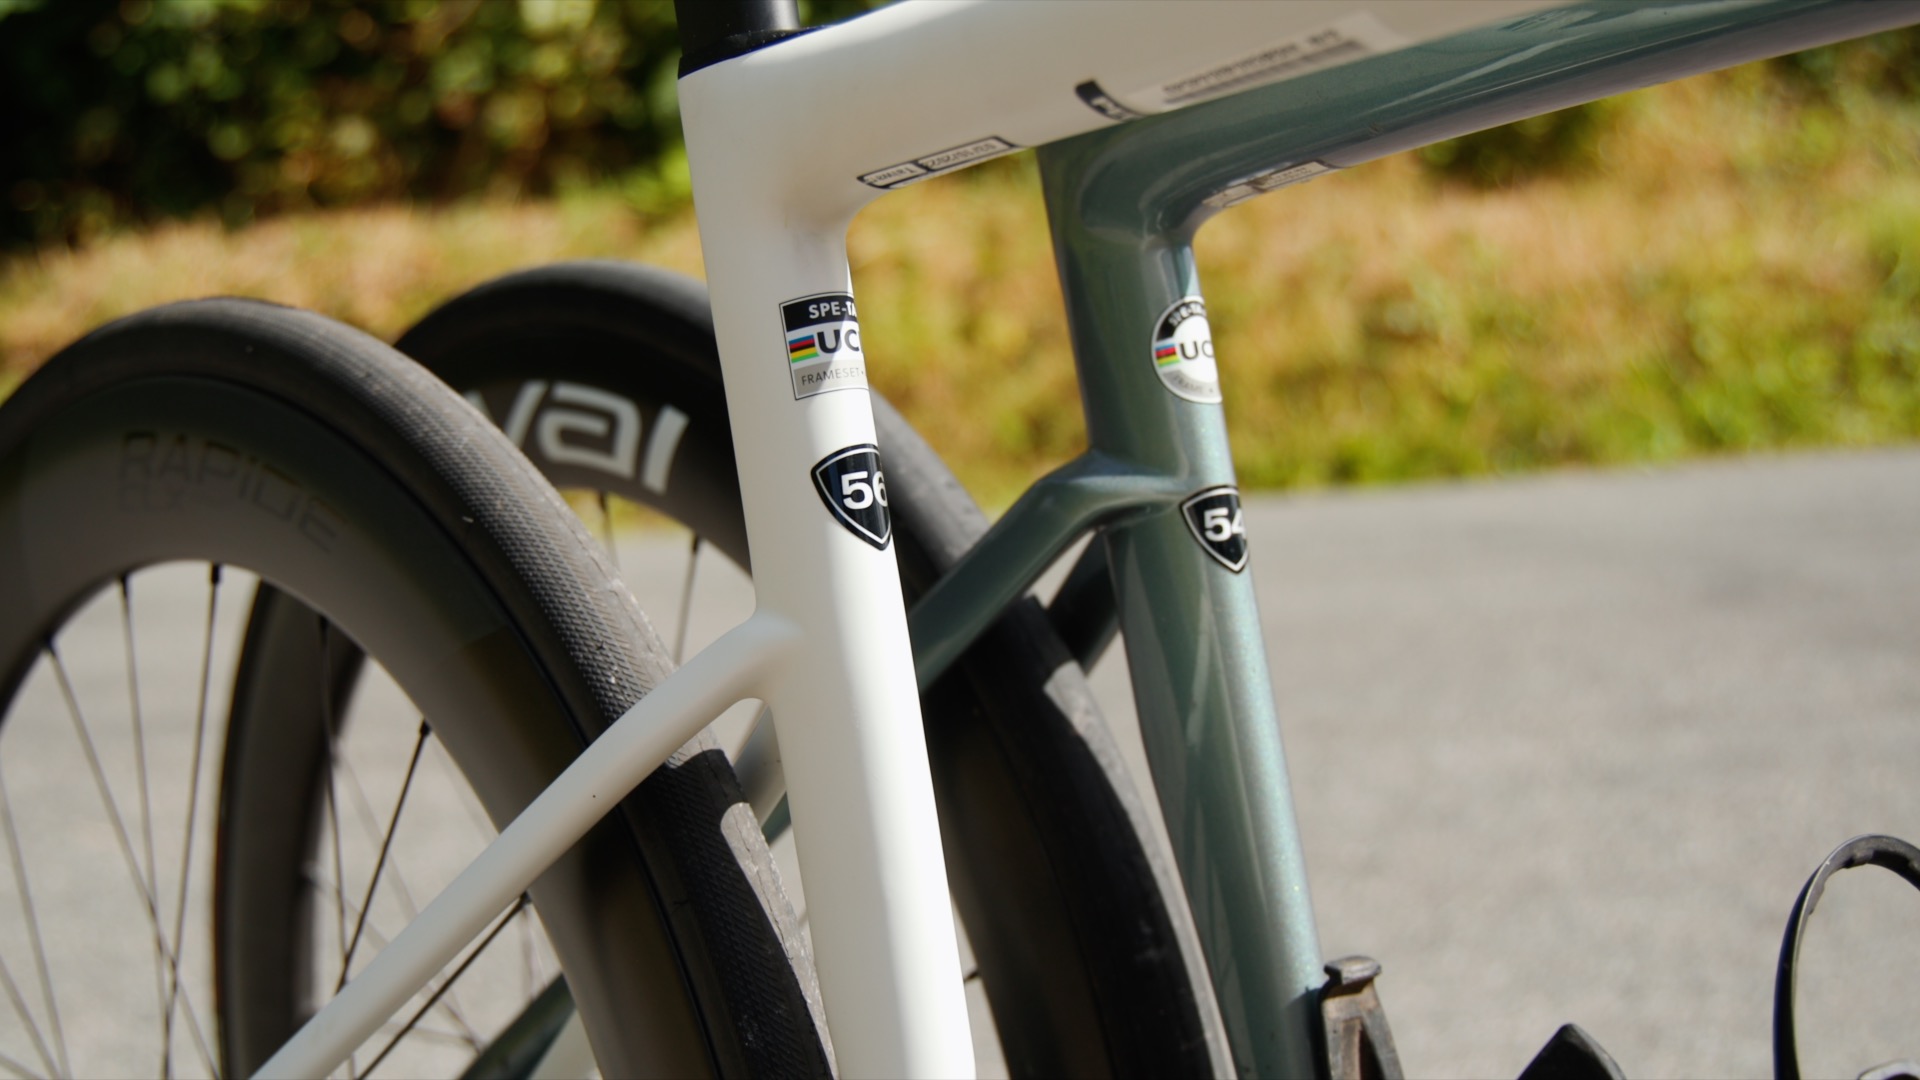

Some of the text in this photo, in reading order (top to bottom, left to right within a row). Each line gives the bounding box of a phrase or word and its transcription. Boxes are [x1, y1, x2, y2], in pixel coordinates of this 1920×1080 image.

[118, 430, 348, 552] RAPIDE
[842, 471, 888, 509] 56
[1204, 507, 1246, 541] 54
